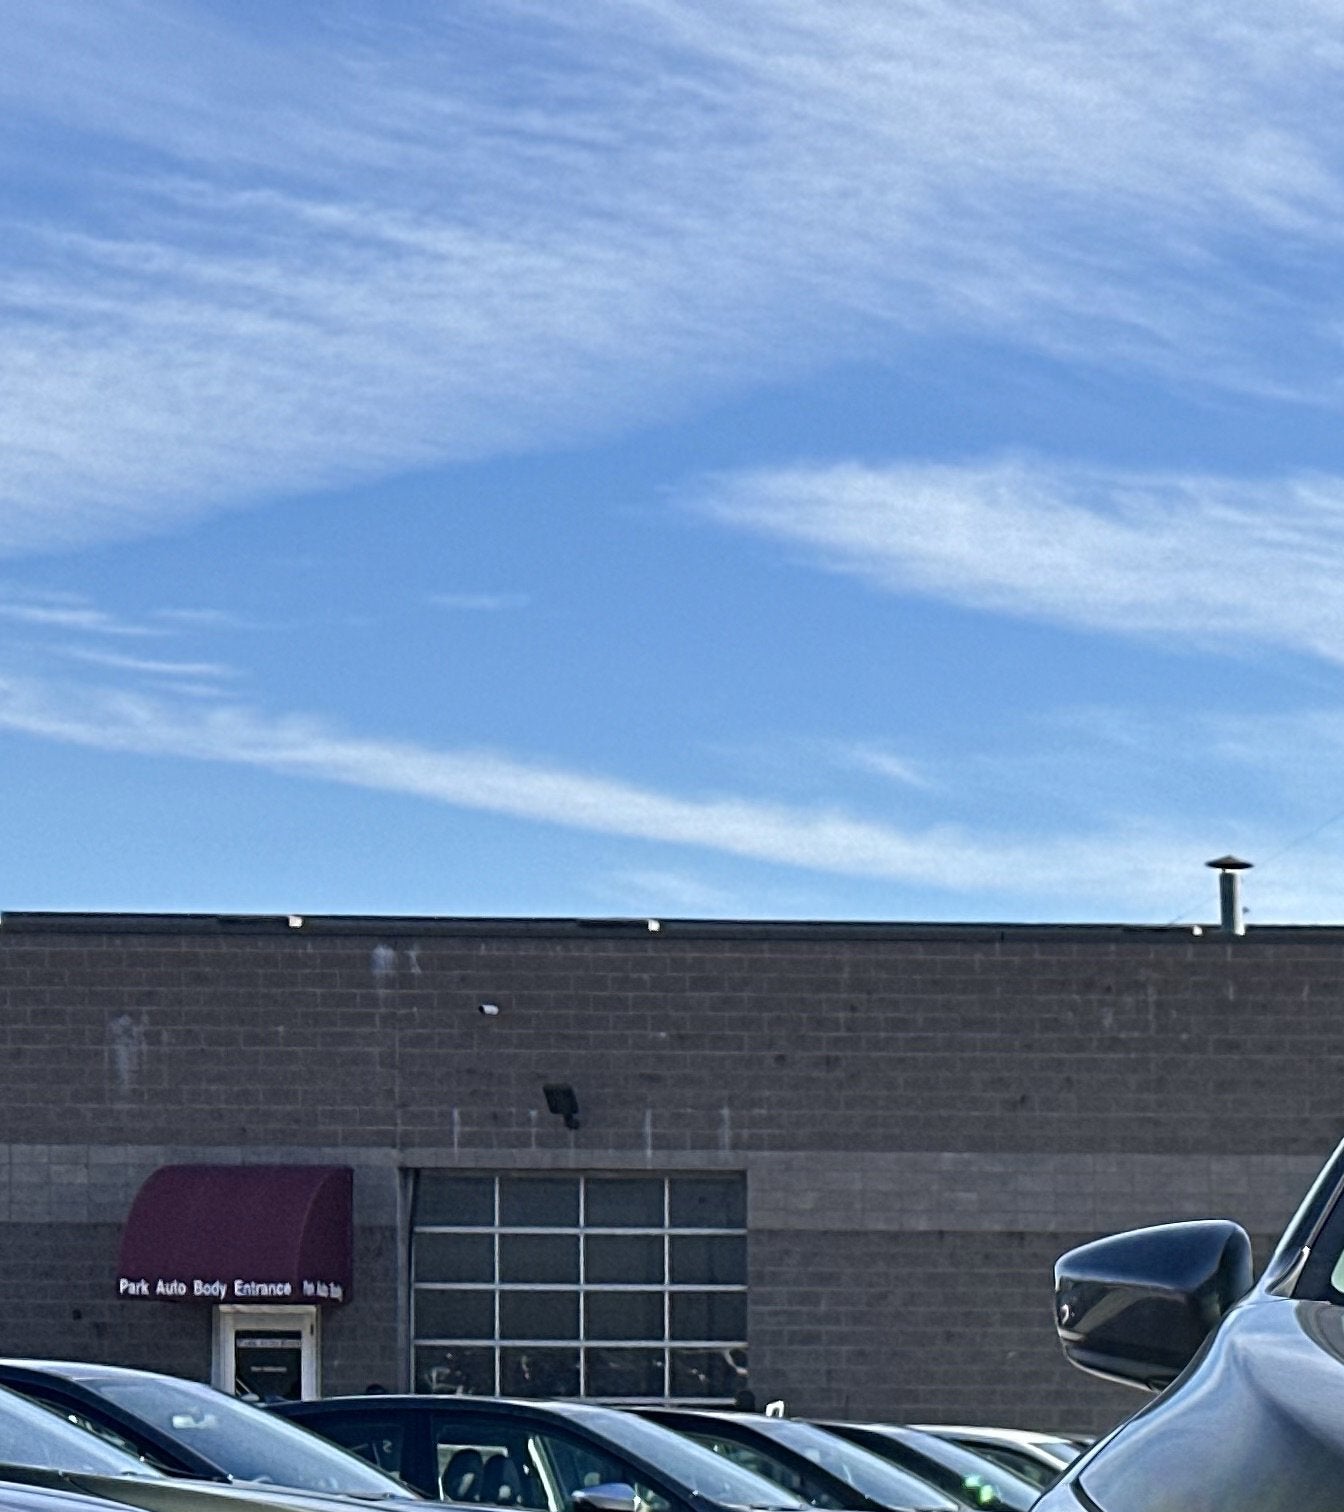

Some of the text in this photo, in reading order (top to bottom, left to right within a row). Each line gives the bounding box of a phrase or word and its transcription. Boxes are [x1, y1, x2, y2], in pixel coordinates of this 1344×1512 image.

[120, 1278, 149, 1296] Park
[156, 1279, 187, 1296] Auto
[193, 1280, 227, 1300] Body
[234, 1279, 292, 1297] Entrance
